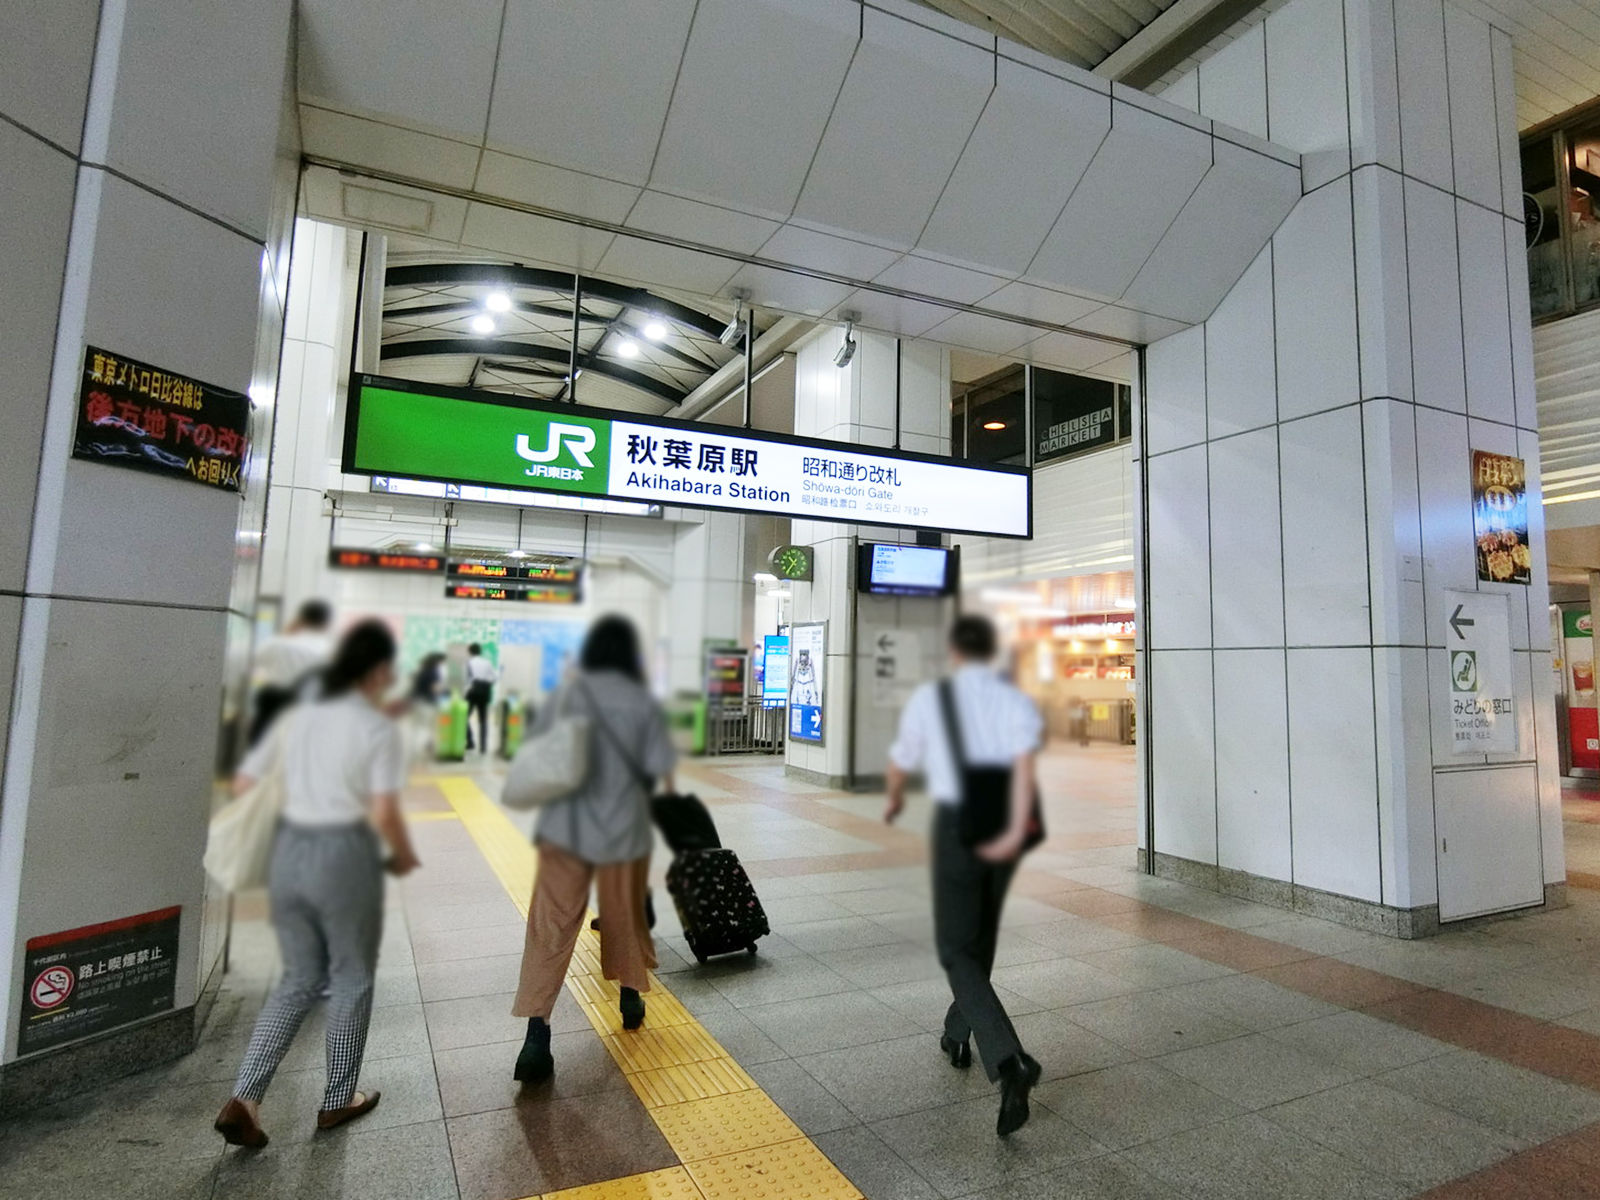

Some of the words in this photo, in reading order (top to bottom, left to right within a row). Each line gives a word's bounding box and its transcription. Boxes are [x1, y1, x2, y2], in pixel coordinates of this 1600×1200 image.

[91, 354, 204, 410] 東京メトロ日比谷線は
[516, 421, 596, 468] JR
[627, 434, 758, 477] 秋葉原駅
[1040, 426, 1099, 454] MARKET
[525, 464, 584, 481] JR東日本
[626, 471, 722, 496] Akihabara
[729, 482, 790, 503] Station
[803, 456, 902, 487] 昭和通り改札
[868, 487, 894, 500] Gate
[1453, 698, 1511, 715] みどりの窓口
[79, 945, 163, 980] 路上喫煙禁止
